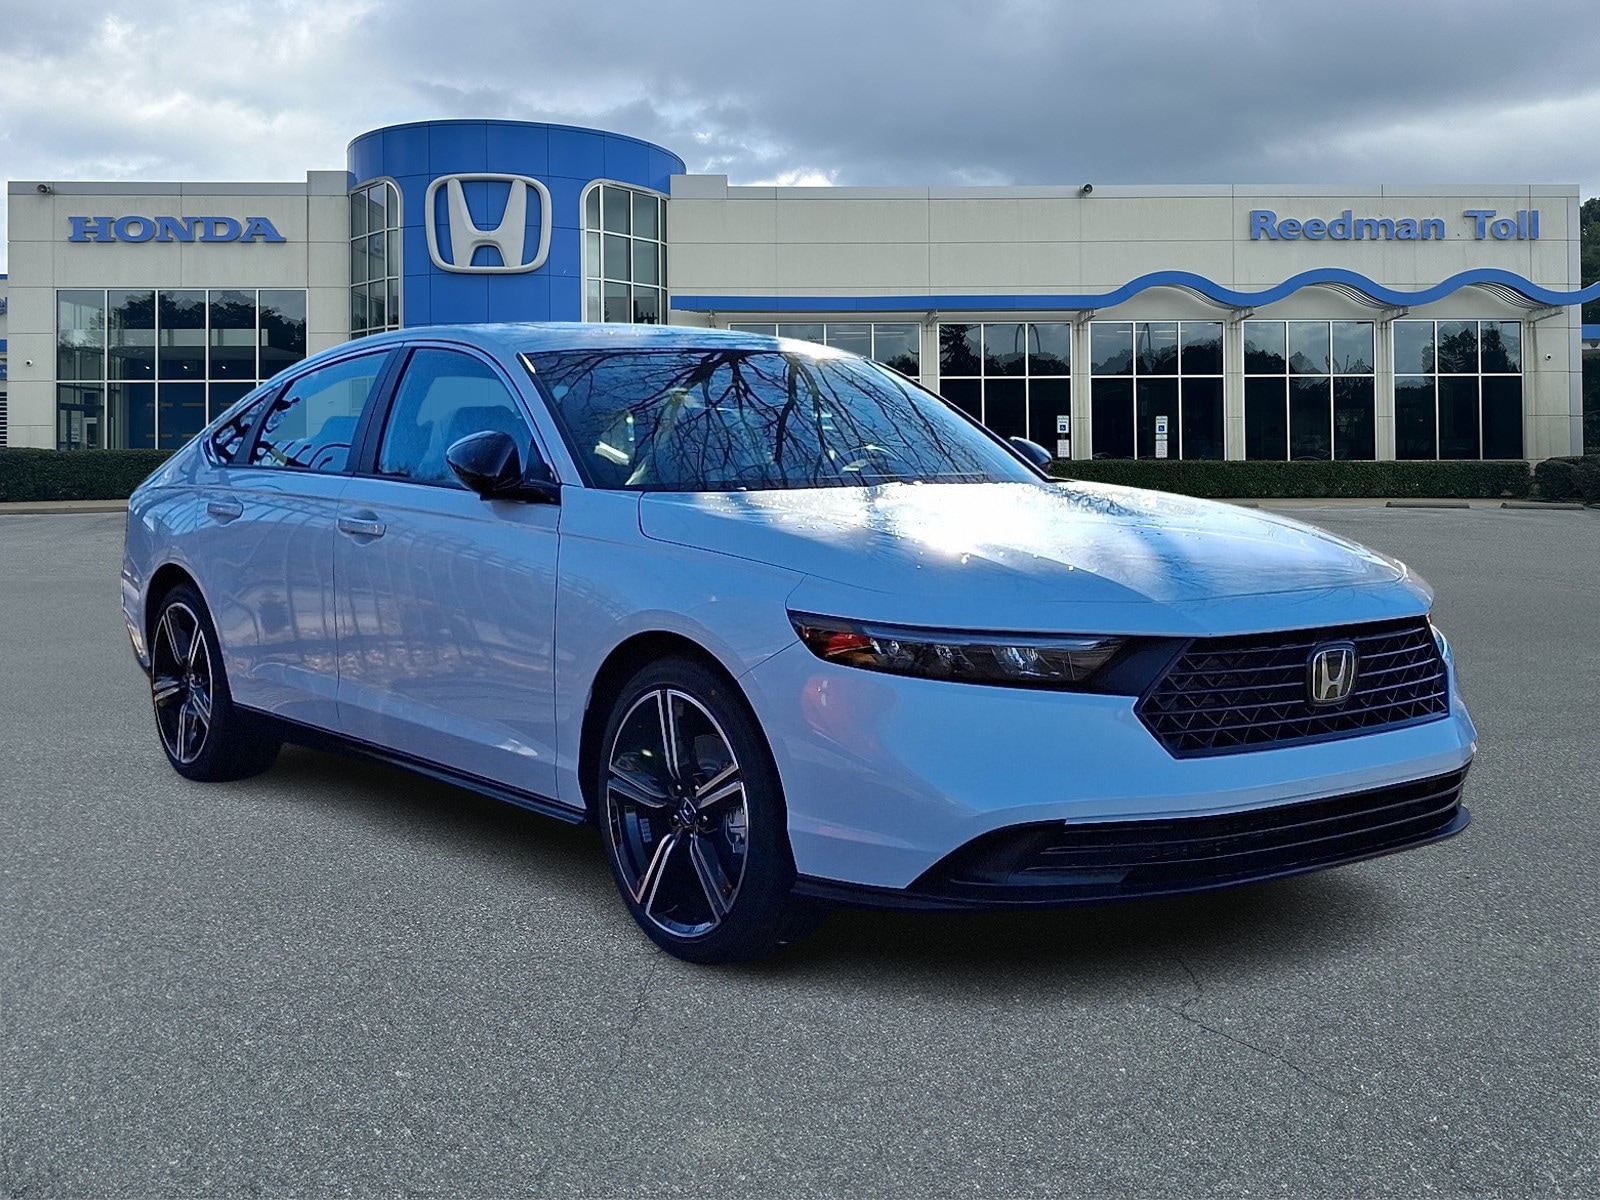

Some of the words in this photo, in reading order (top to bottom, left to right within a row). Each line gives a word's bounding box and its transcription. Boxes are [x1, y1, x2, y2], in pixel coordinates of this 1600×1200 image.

[68, 215, 287, 243] HONDA
[1250, 209, 1446, 241] Reedman
[1463, 209, 1540, 241] Toll
